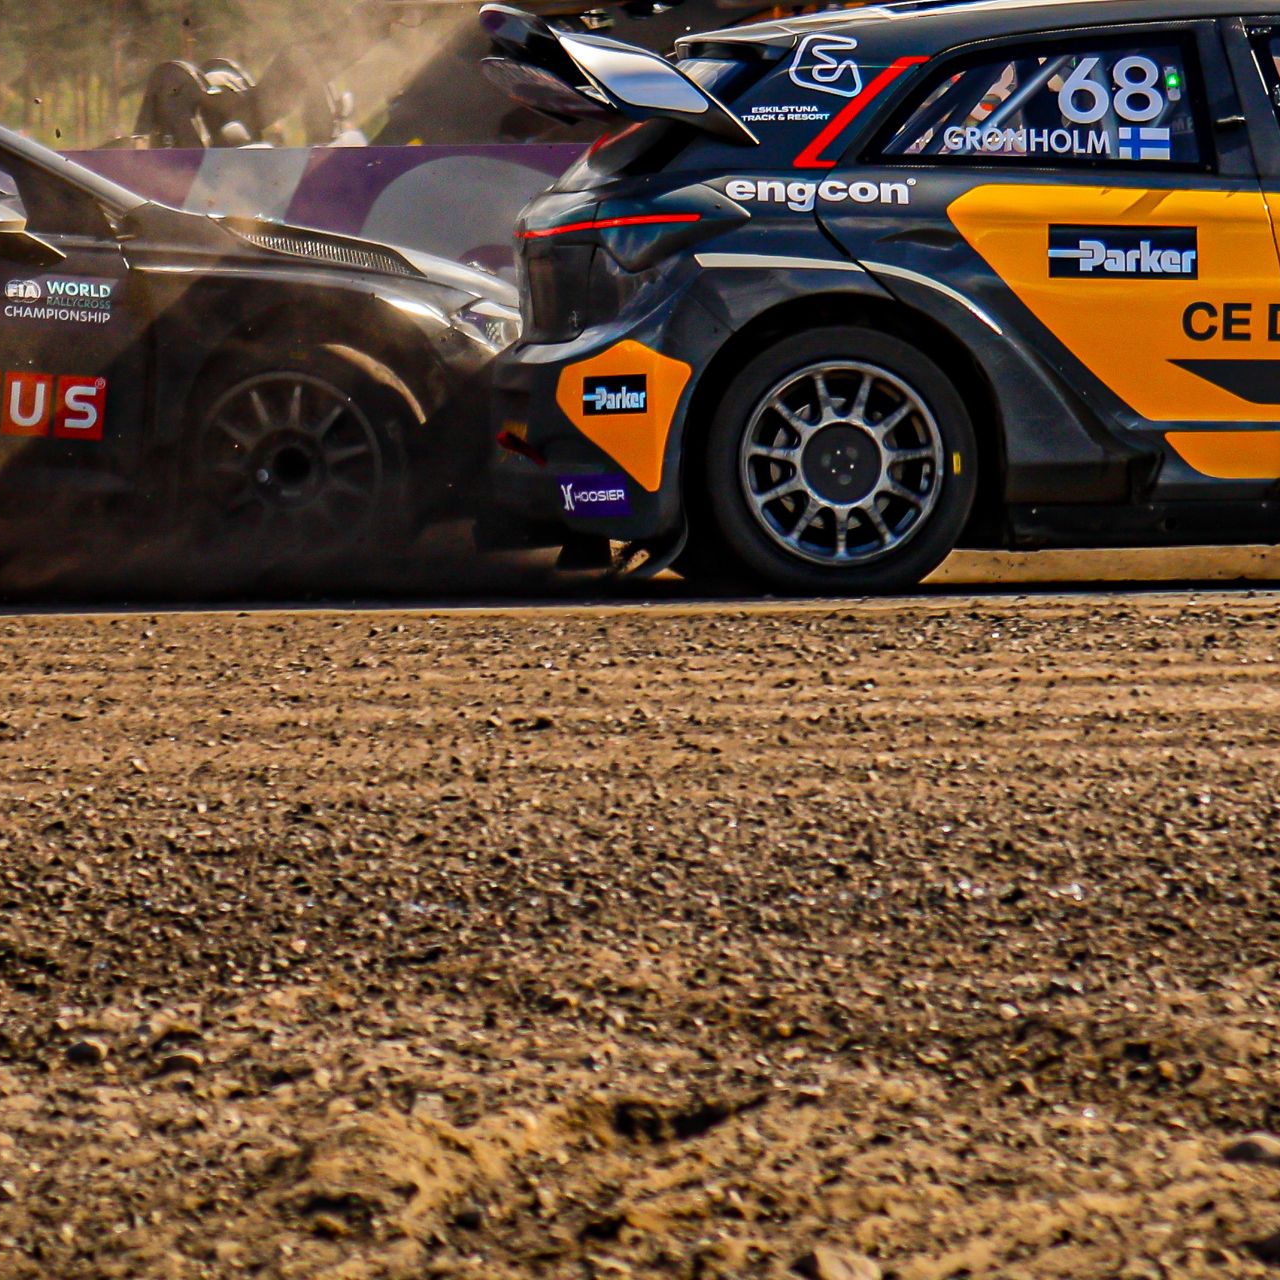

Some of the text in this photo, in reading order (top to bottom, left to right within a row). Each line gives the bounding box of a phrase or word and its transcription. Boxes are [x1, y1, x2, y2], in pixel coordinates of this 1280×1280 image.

[1058, 56, 1164, 124] 68
[741, 112, 830, 122] TRACK & RESORT
[751, 105, 819, 114] ESKILSTUNA
[725, 180, 910, 212] engcon
[1078, 240, 1197, 273] Parker
[6, 281, 111, 299] FIA WORLD
[46, 296, 111, 309] RALLYCROSS
[4, 306, 111, 324] CHAMPIONSHIP
[1182, 302, 1252, 341] CE
[595, 386, 646, 411] Parker
[573, 489, 625, 503] HOOSIER
